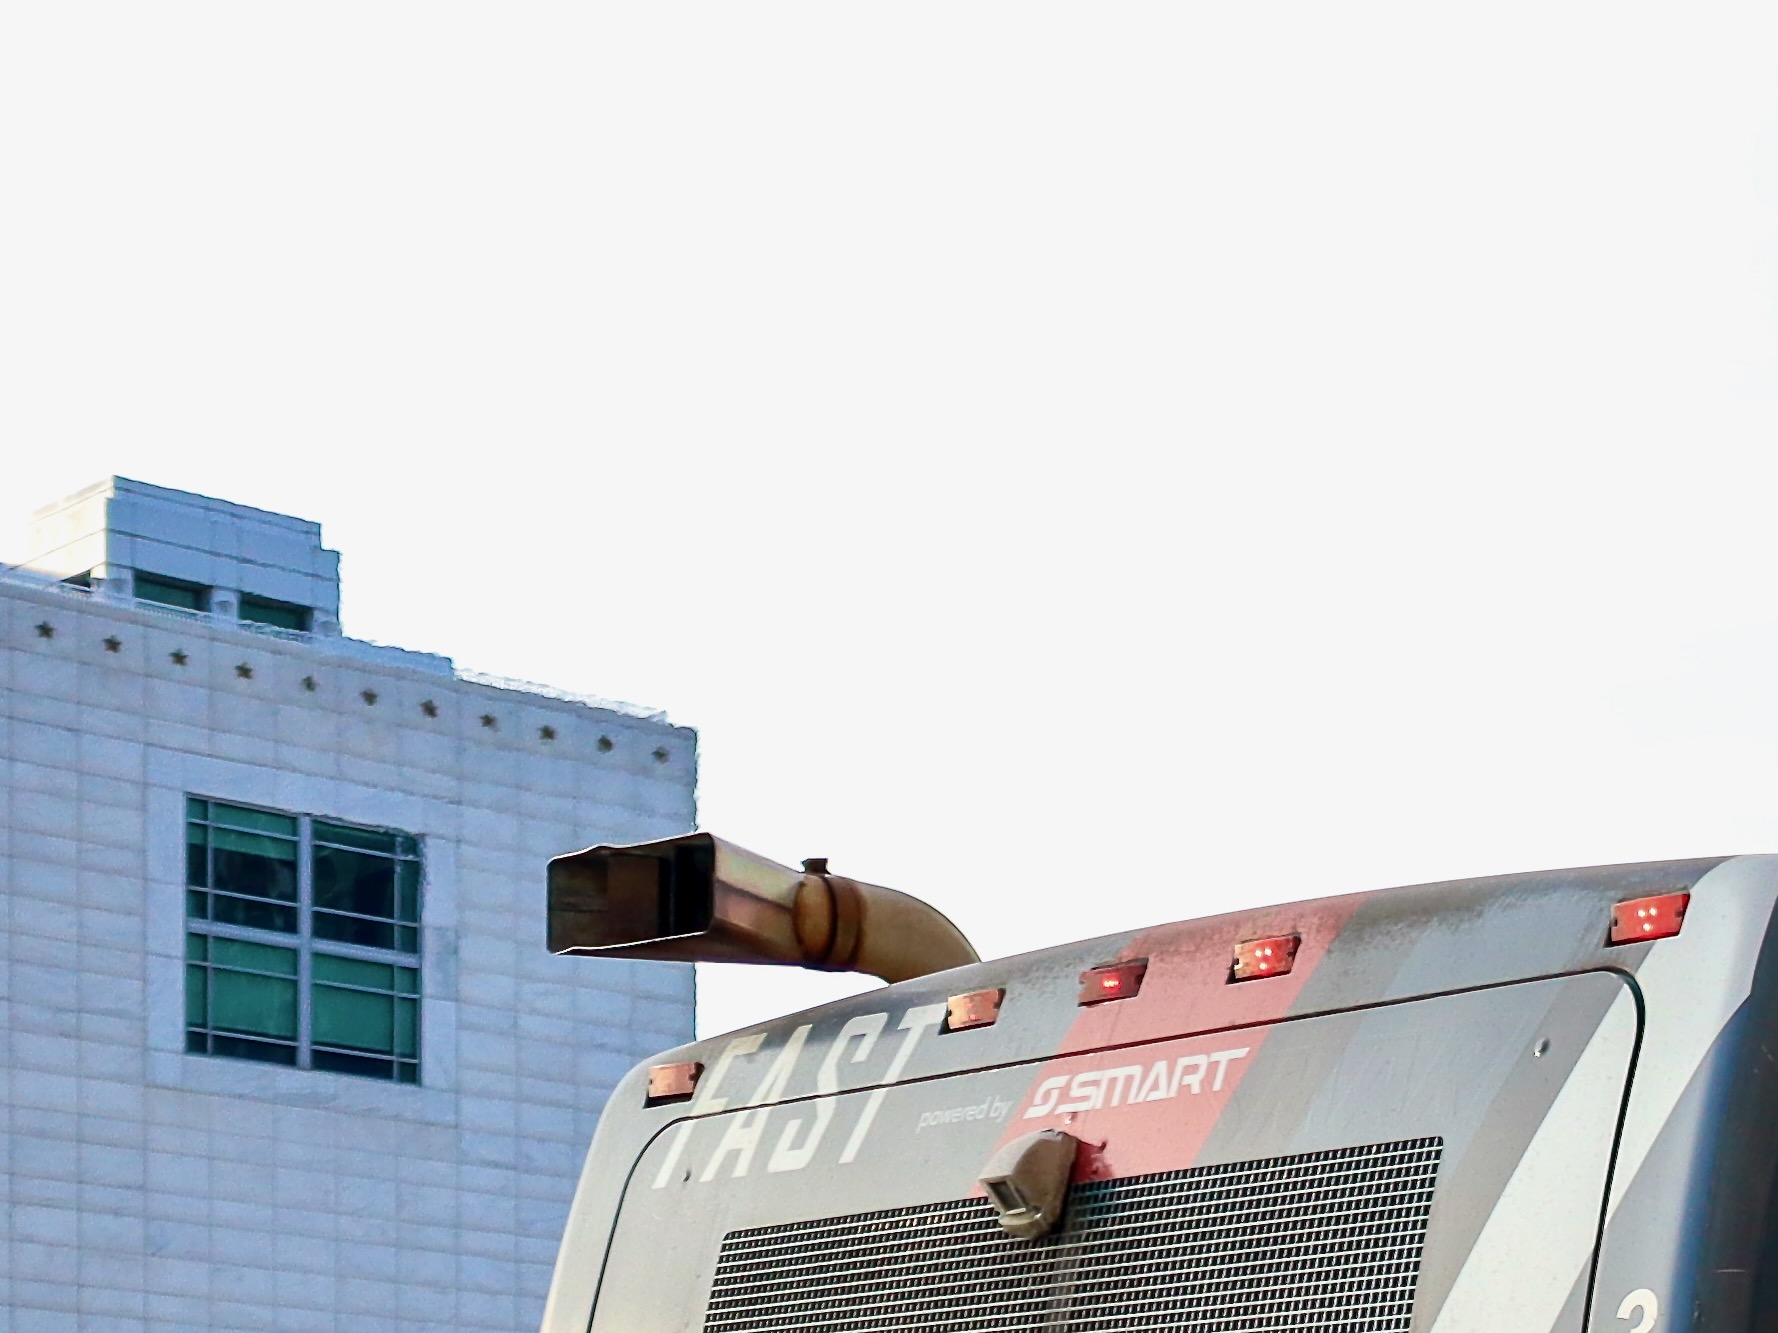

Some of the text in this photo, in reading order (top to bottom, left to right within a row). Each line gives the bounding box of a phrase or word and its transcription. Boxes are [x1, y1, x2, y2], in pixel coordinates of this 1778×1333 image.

[651, 1002, 951, 1190] FAST
[916, 1047, 1251, 1132] powered by SMART
